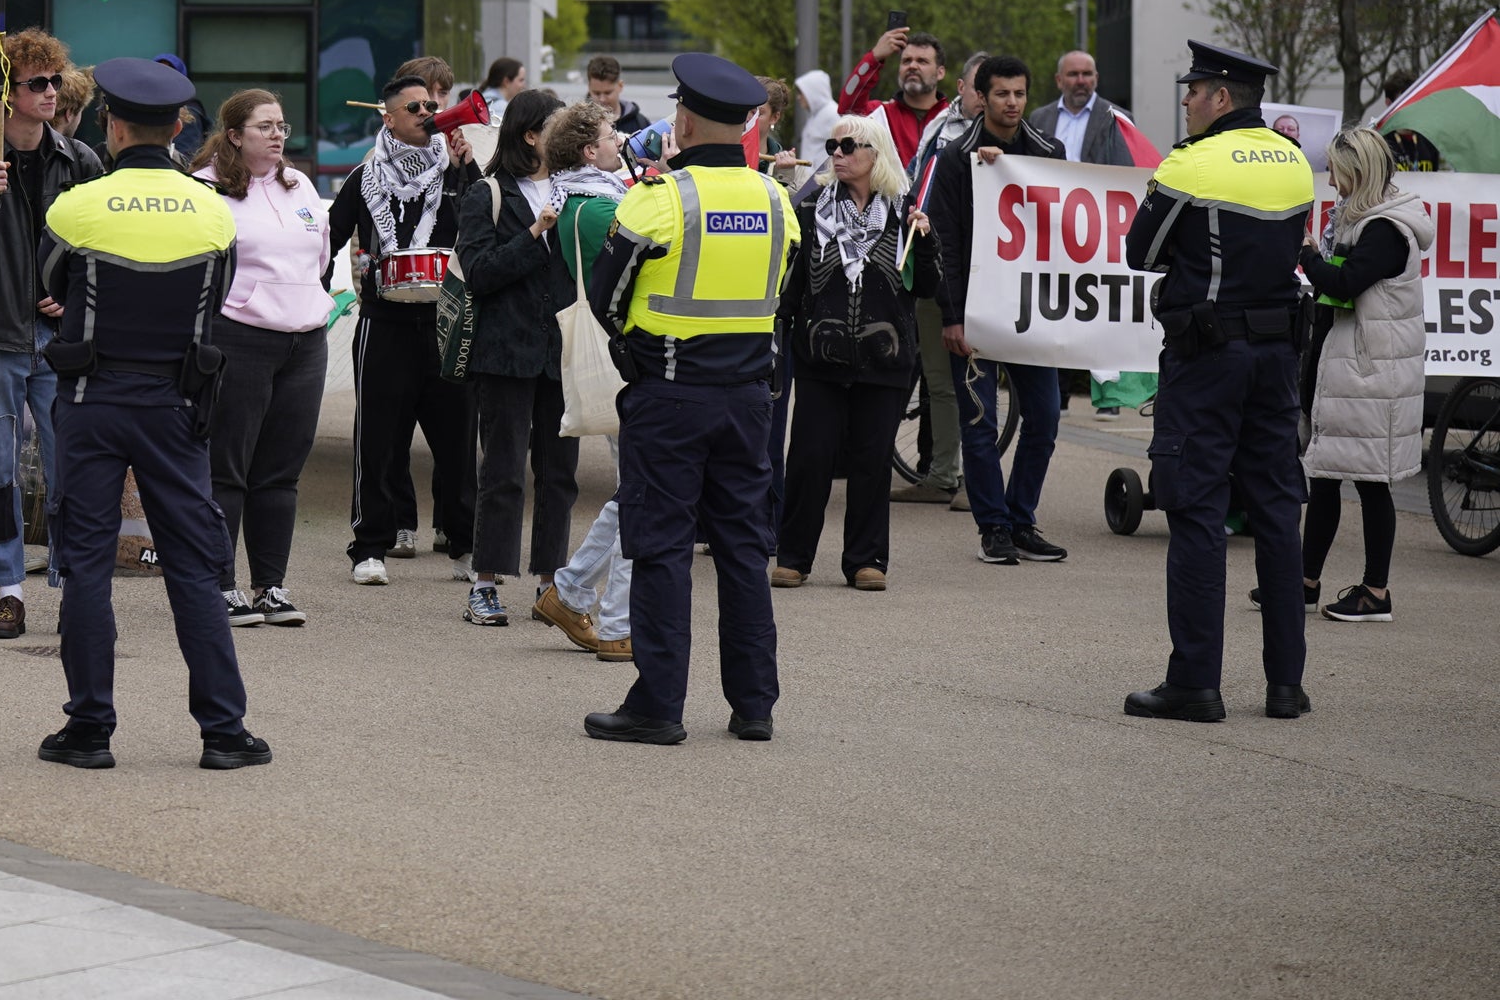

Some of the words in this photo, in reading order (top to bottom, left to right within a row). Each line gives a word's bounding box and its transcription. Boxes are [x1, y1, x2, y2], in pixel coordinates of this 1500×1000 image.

[1231, 150, 1300, 164] GARDA
[107, 196, 197, 213] GARDA
[709, 215, 766, 230] GARDA
[997, 183, 1138, 264] STOP
[453, 338, 472, 378] BOOKS
